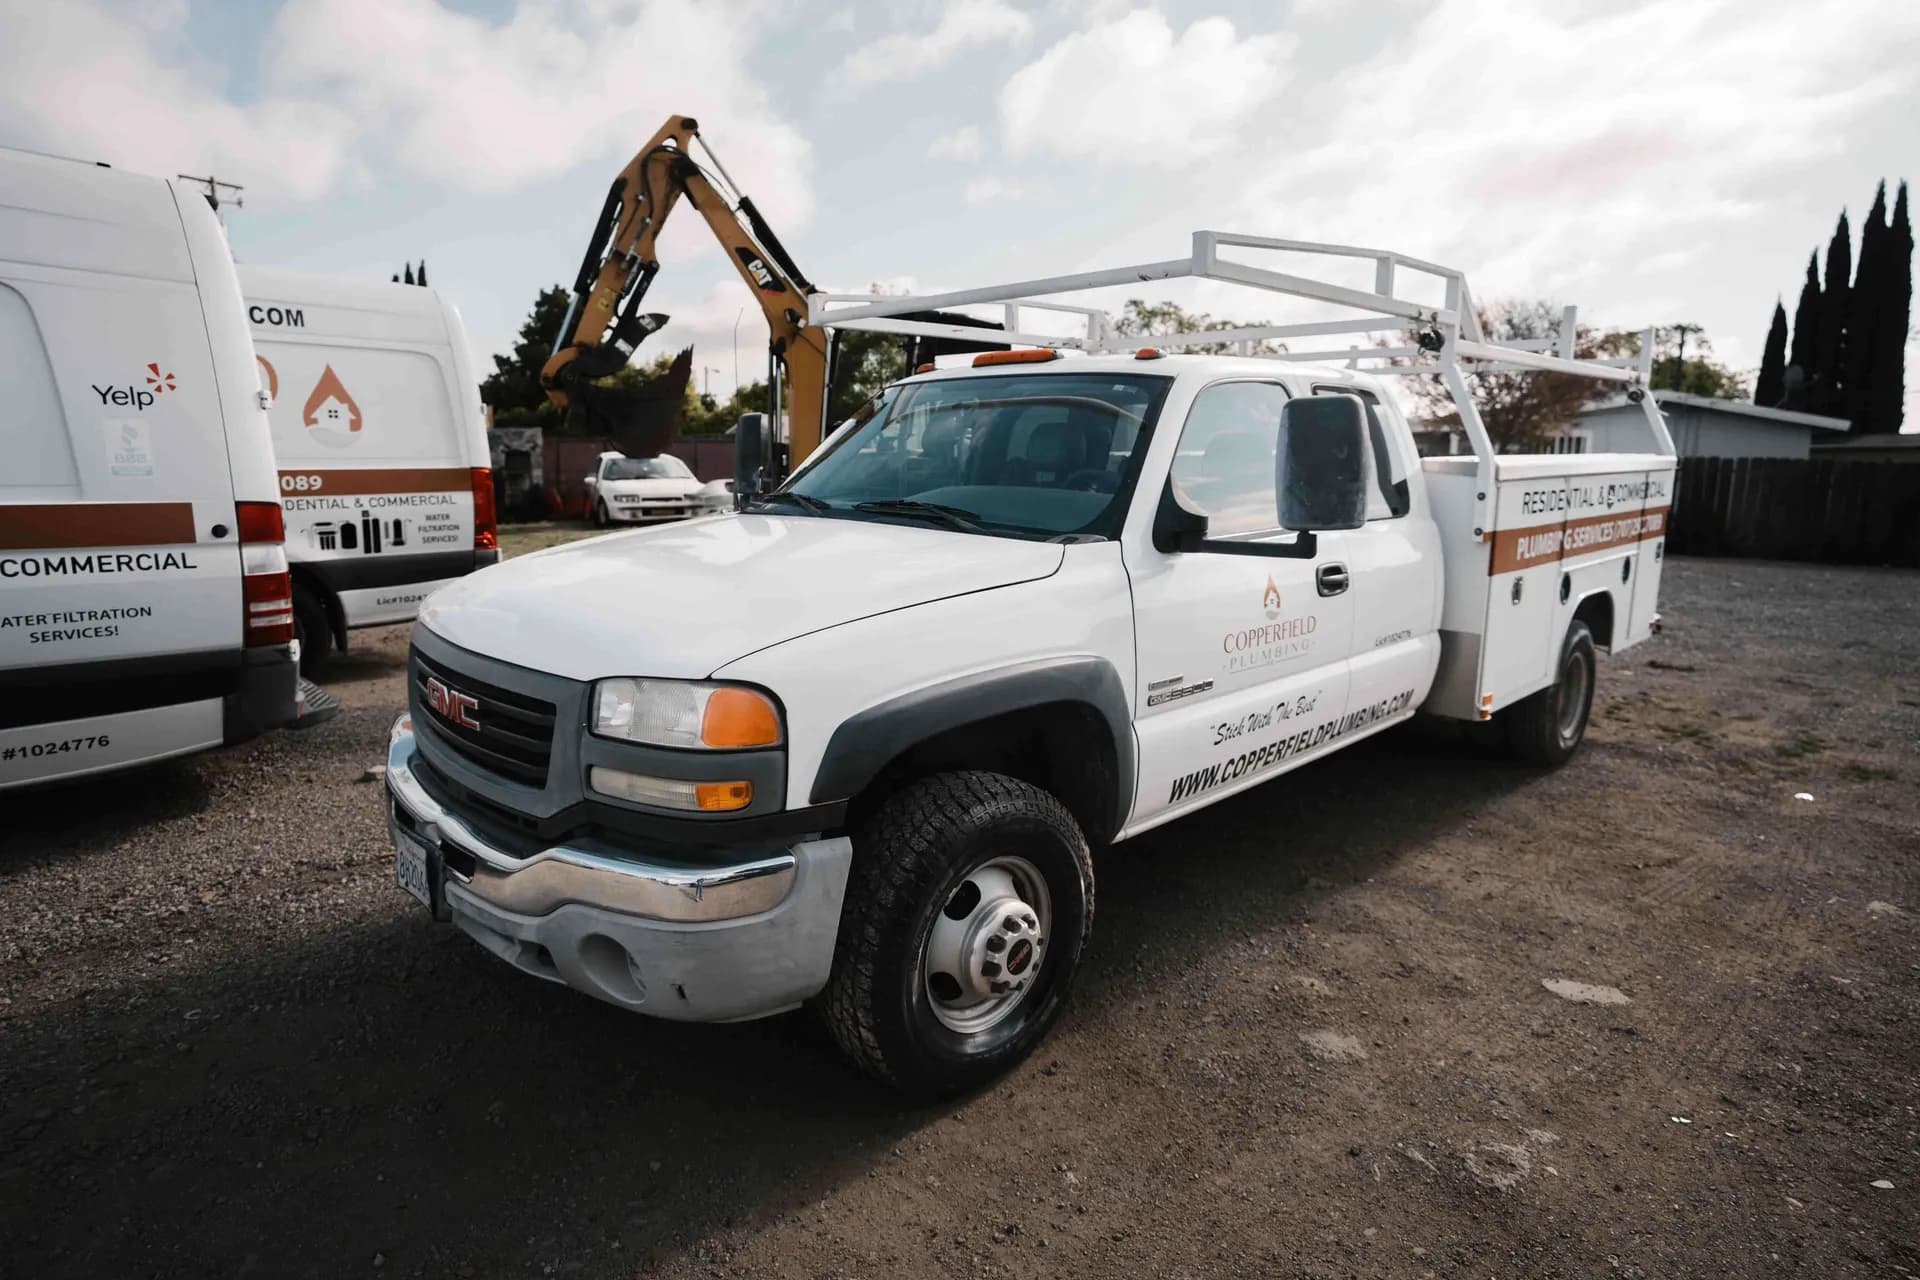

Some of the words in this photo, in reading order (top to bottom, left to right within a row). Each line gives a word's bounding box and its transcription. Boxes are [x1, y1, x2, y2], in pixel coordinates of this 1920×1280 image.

[747, 258, 773, 286] CAT
[248, 305, 305, 328] COM
[91, 384, 154, 411] Yelp
[280, 475, 323, 491] 089
[284, 498, 349, 511] DENTIAL
[353, 498, 364, 508] &
[368, 496, 457, 508] COMMERCIAL
[1521, 487, 1595, 515] RESIDENTIAL
[418, 524, 460, 533] FILTRATION
[425, 513, 451, 521] WATER
[0, 552, 198, 578] COMMERCIAL
[0, 614, 48, 628] ATER
[52, 606, 152, 624] FILTRATION
[29, 625, 120, 644] SERVICES!
[1223, 615, 1317, 654] COPPERFIELD
[427, 677, 480, 731] GMC
[1247, 705, 1274, 733] With
[1276, 701, 1294, 724] The
[1169, 688, 1416, 804] WWW.COPPERFIELDPLUMBING.COM
